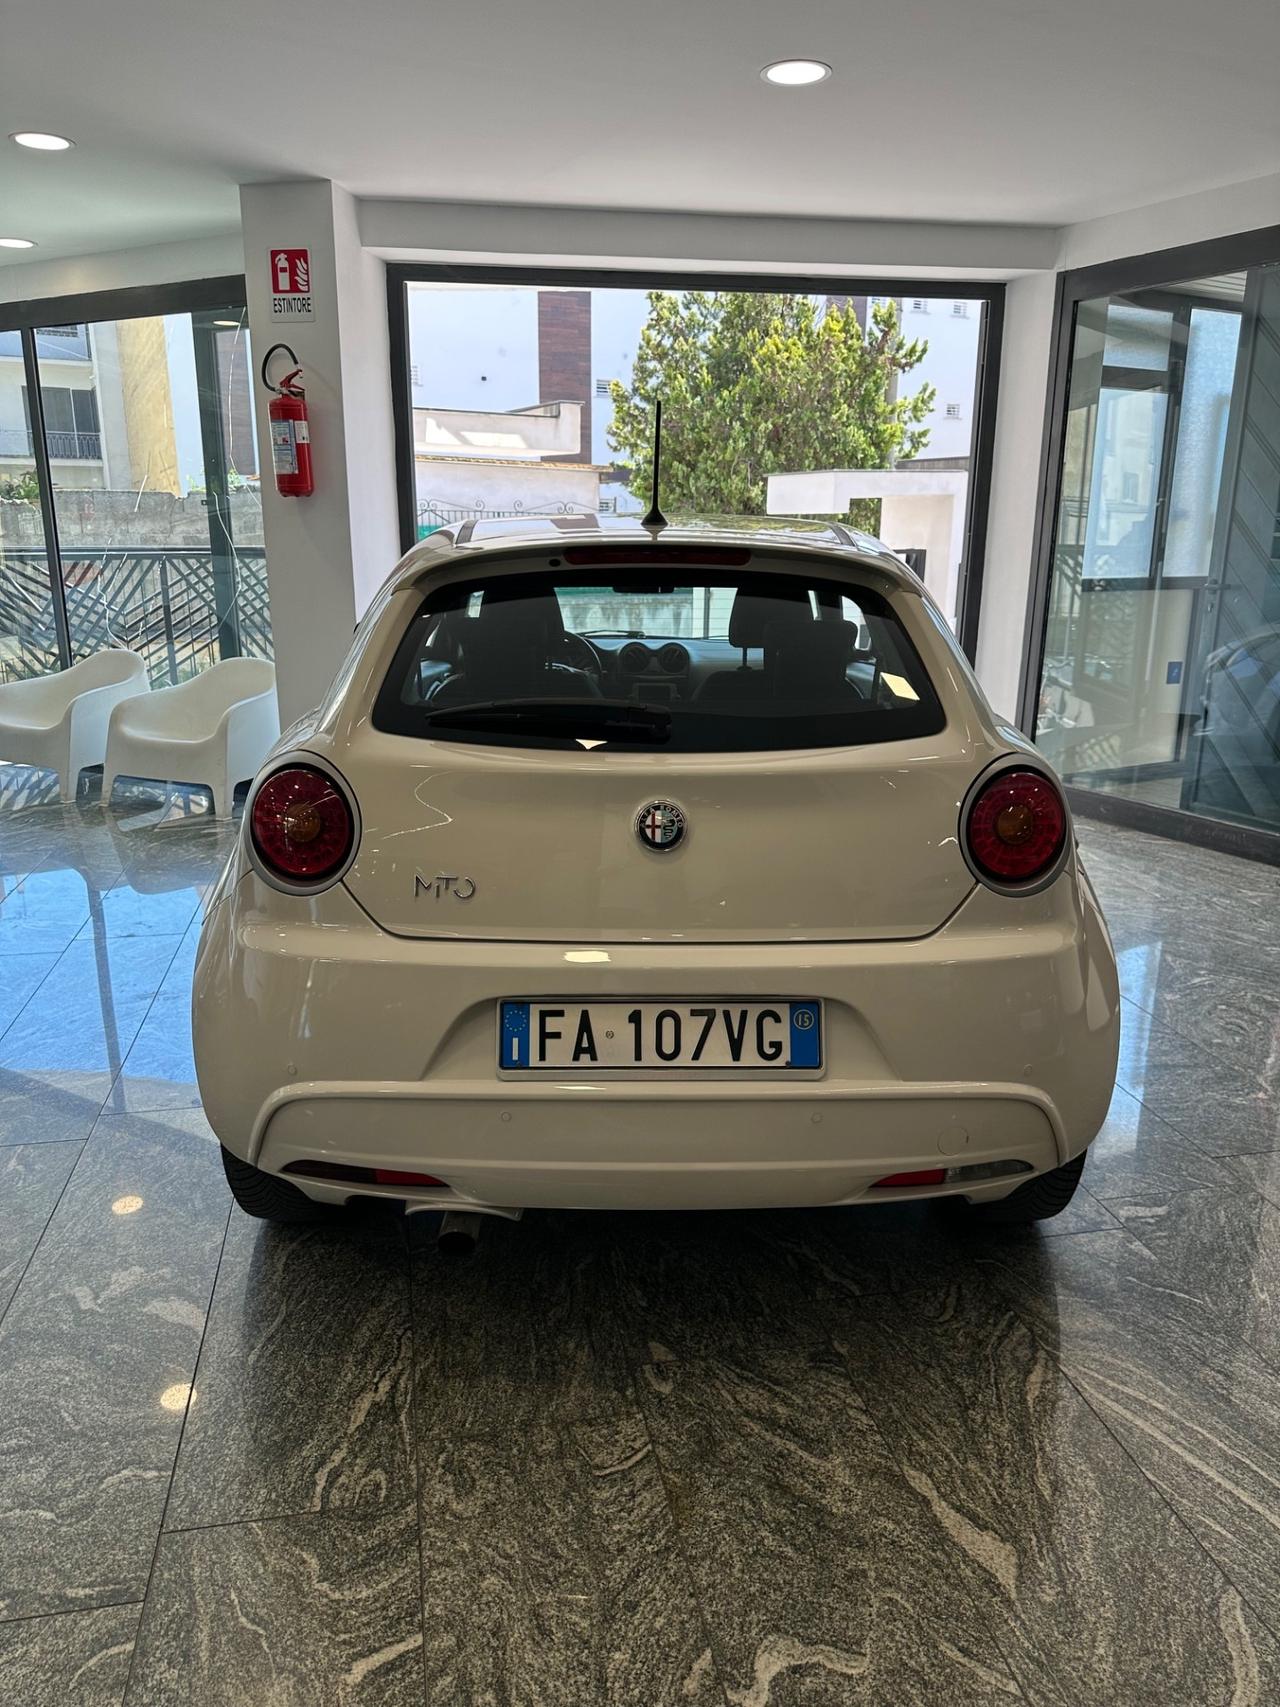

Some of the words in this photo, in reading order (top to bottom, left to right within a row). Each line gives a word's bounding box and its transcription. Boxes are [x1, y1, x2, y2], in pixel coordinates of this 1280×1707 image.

[273, 297, 312, 313] ESTINTORE
[798, 1014, 810, 1026] 15
[538, 1009, 598, 1062] FA
[628, 1008, 783, 1062] 107VG
